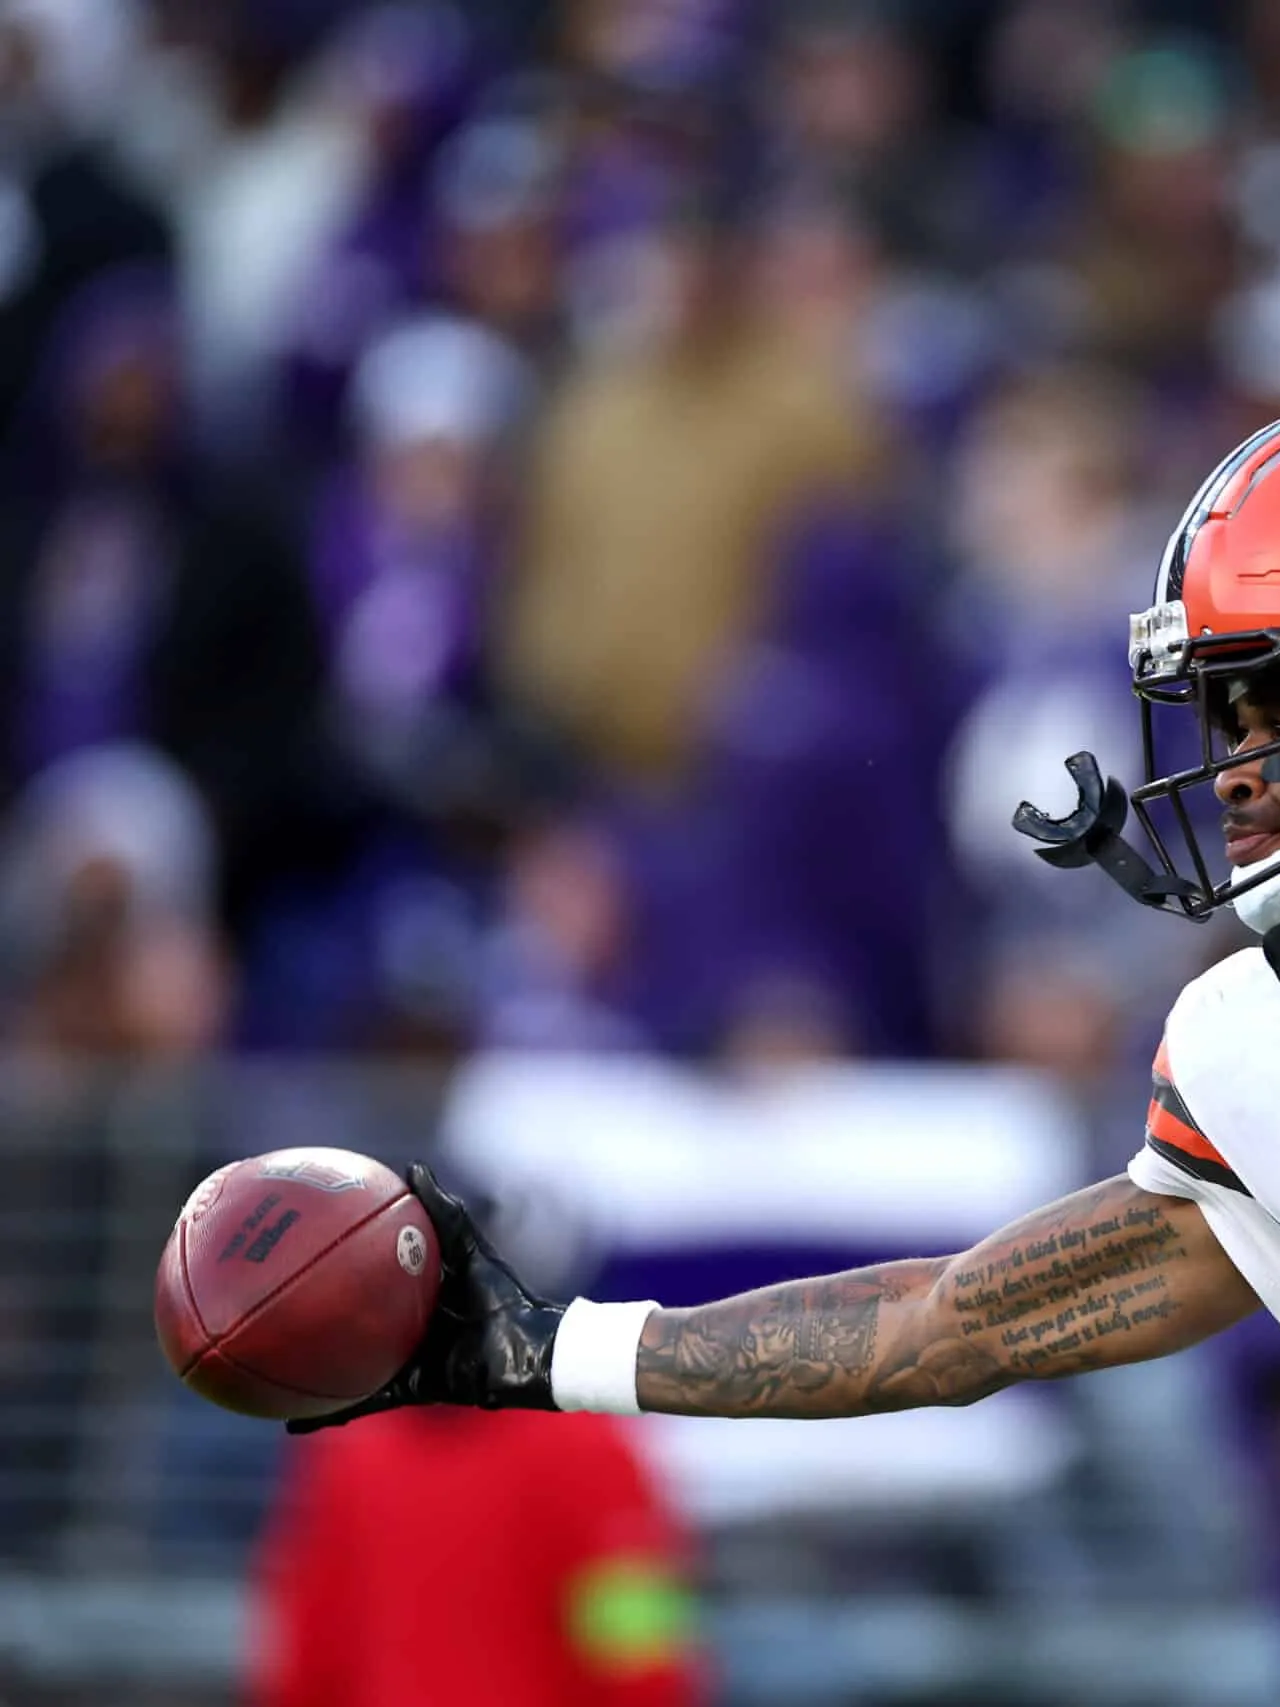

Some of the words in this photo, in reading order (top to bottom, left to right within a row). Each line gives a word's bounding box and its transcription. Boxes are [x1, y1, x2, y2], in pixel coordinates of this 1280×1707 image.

[955, 1268, 984, 1288] Many
[1027, 1233, 1057, 1260] think
[1059, 1229, 1086, 1248] they
[1089, 1217, 1120, 1238] want
[1001, 1327, 1028, 1346] that
[1030, 1320, 1054, 1341] you
[1057, 1308, 1075, 1331] get
[1077, 1294, 1108, 1315] what
[1110, 1288, 1134, 1309] you
